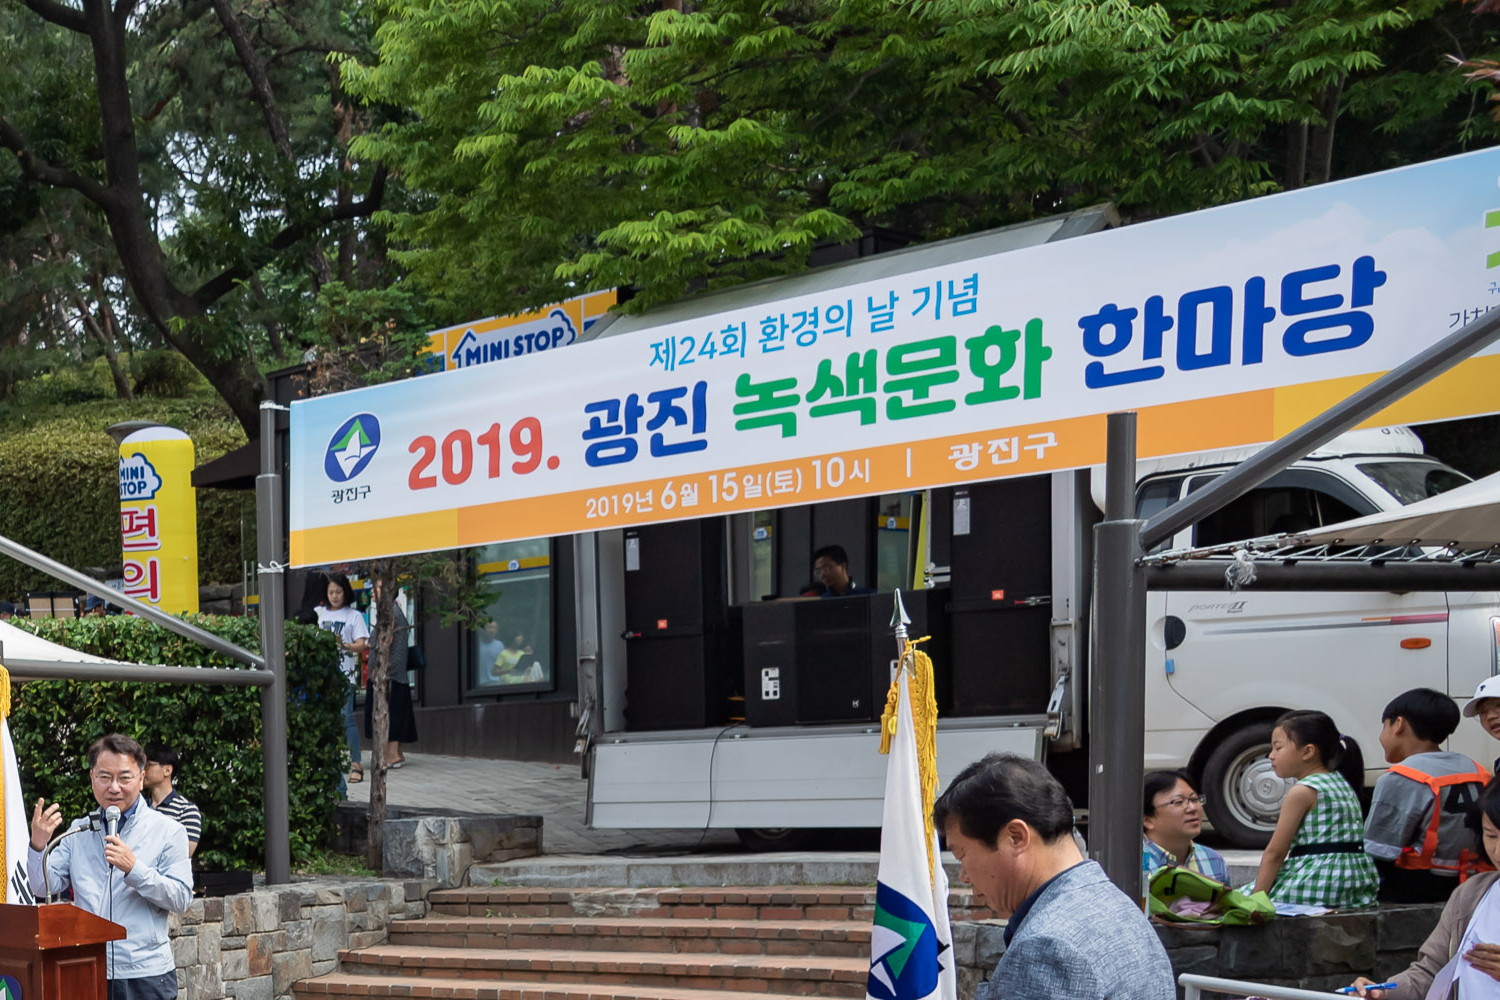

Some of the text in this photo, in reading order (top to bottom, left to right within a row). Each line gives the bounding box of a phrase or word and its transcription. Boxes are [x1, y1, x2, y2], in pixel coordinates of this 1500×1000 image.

[649, 273, 979, 371] 제24회 환경의 날 기념
[408, 255, 1387, 490] 2019. 광진 녹색문화 한마당
[331, 484, 373, 505] 광진구
[585, 432, 1059, 519] 2019년 6월 15일(토) 10시 광진구
